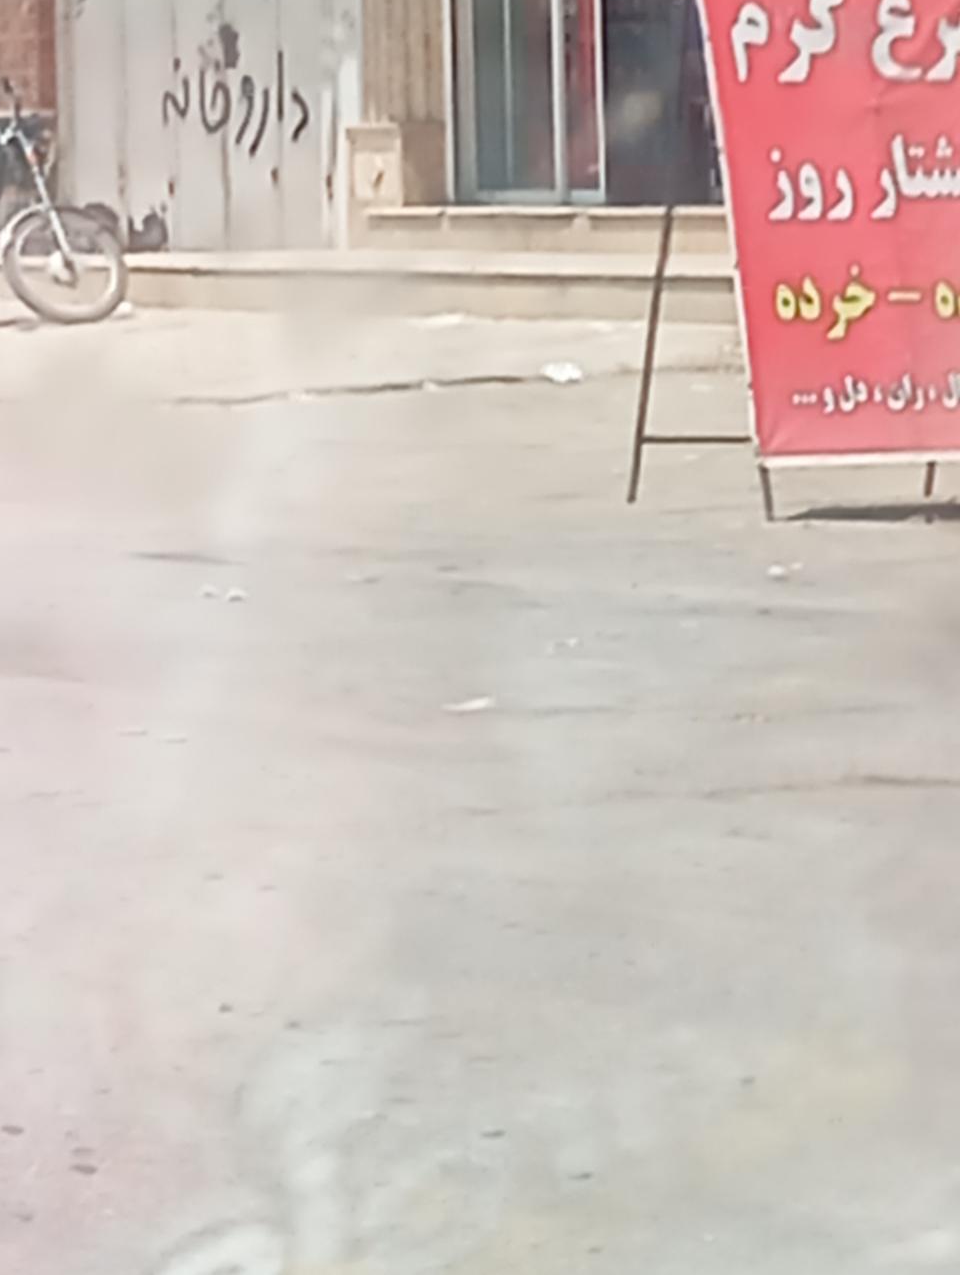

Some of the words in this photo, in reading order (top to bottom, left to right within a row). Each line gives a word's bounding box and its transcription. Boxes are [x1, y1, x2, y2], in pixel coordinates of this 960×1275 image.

[161, 50, 310, 157] داروخانه
[768, 147, 855, 221] روز
[870, 133, 960, 220] شتار
[774, 263, 876, 341] خرده
